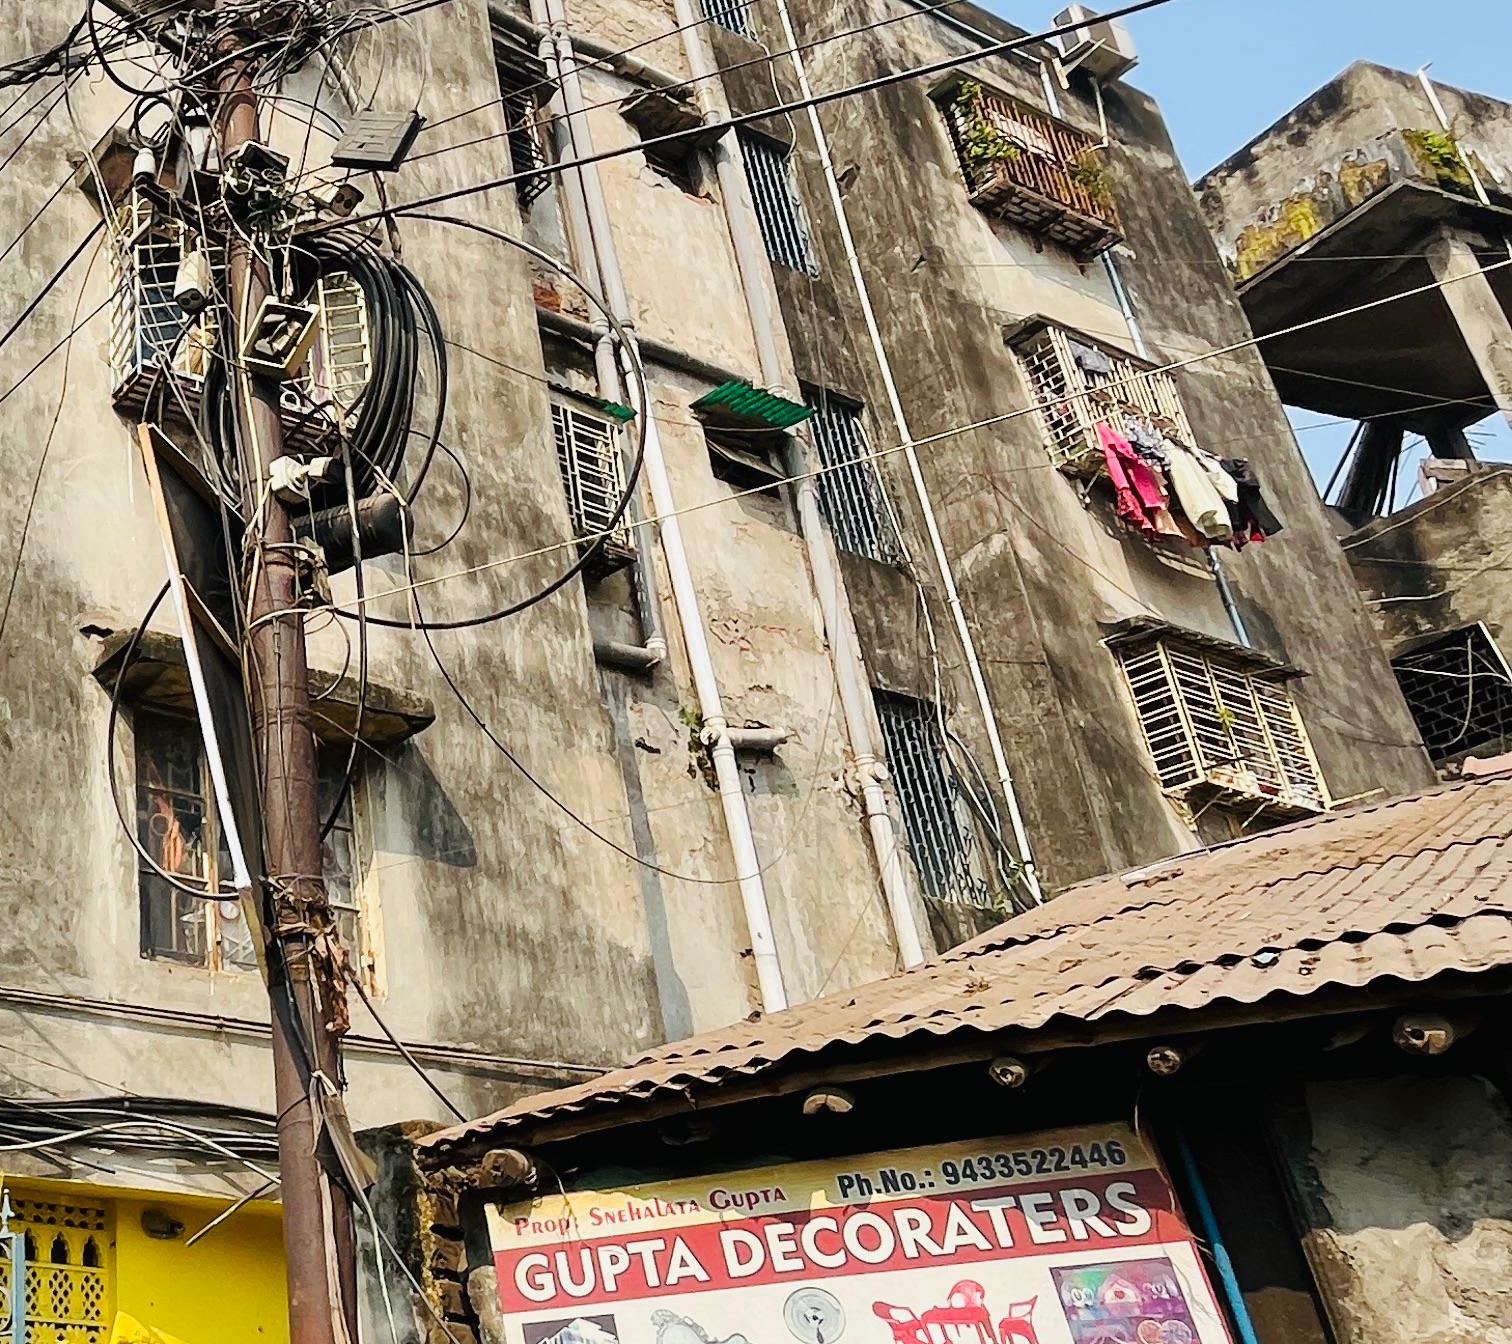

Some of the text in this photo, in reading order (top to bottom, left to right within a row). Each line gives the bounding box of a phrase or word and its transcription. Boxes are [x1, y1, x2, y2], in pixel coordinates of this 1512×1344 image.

[942, 1139, 1127, 1185] 9433522446
[514, 1182, 1153, 1303] GUPTA DECORATERS
